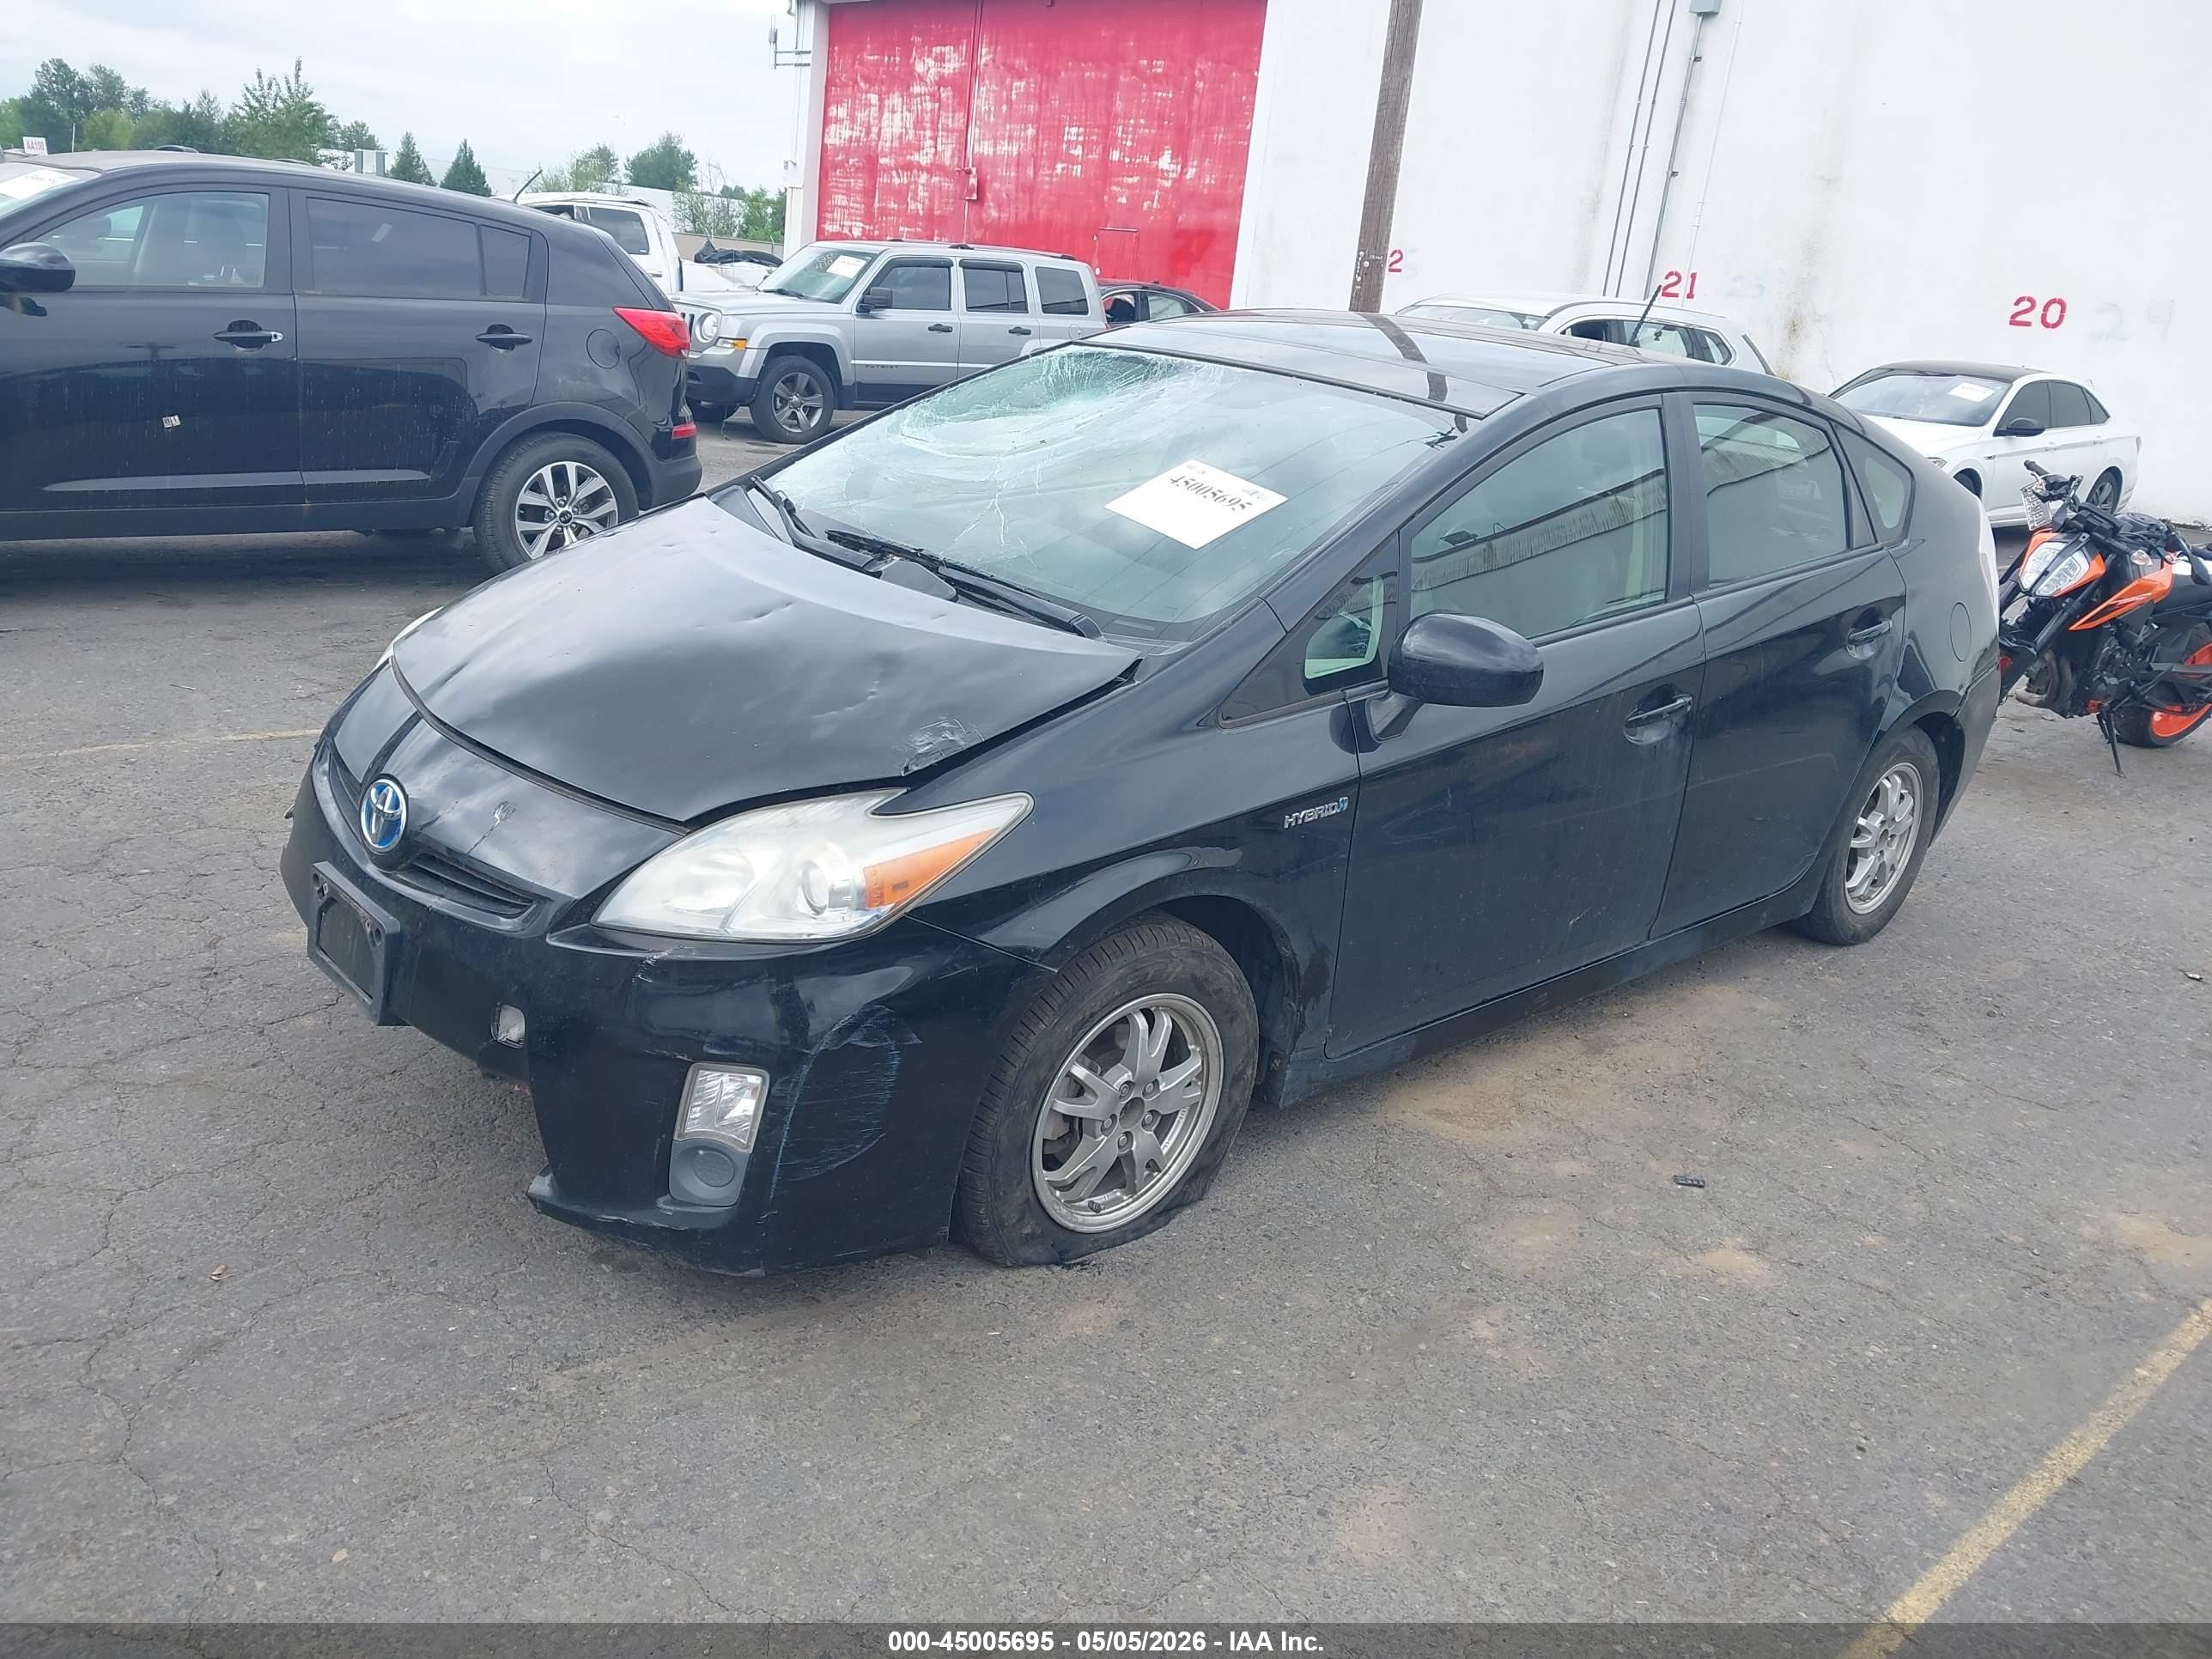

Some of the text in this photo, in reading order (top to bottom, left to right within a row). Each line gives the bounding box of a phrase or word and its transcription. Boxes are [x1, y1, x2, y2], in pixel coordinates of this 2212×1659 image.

[1389, 249, 1403, 272] 2
[1662, 270, 1697, 299] 21
[2009, 295, 2067, 329] 20
[1170, 476, 1253, 511] 45005695
[1284, 801, 1340, 829] HYBRID
